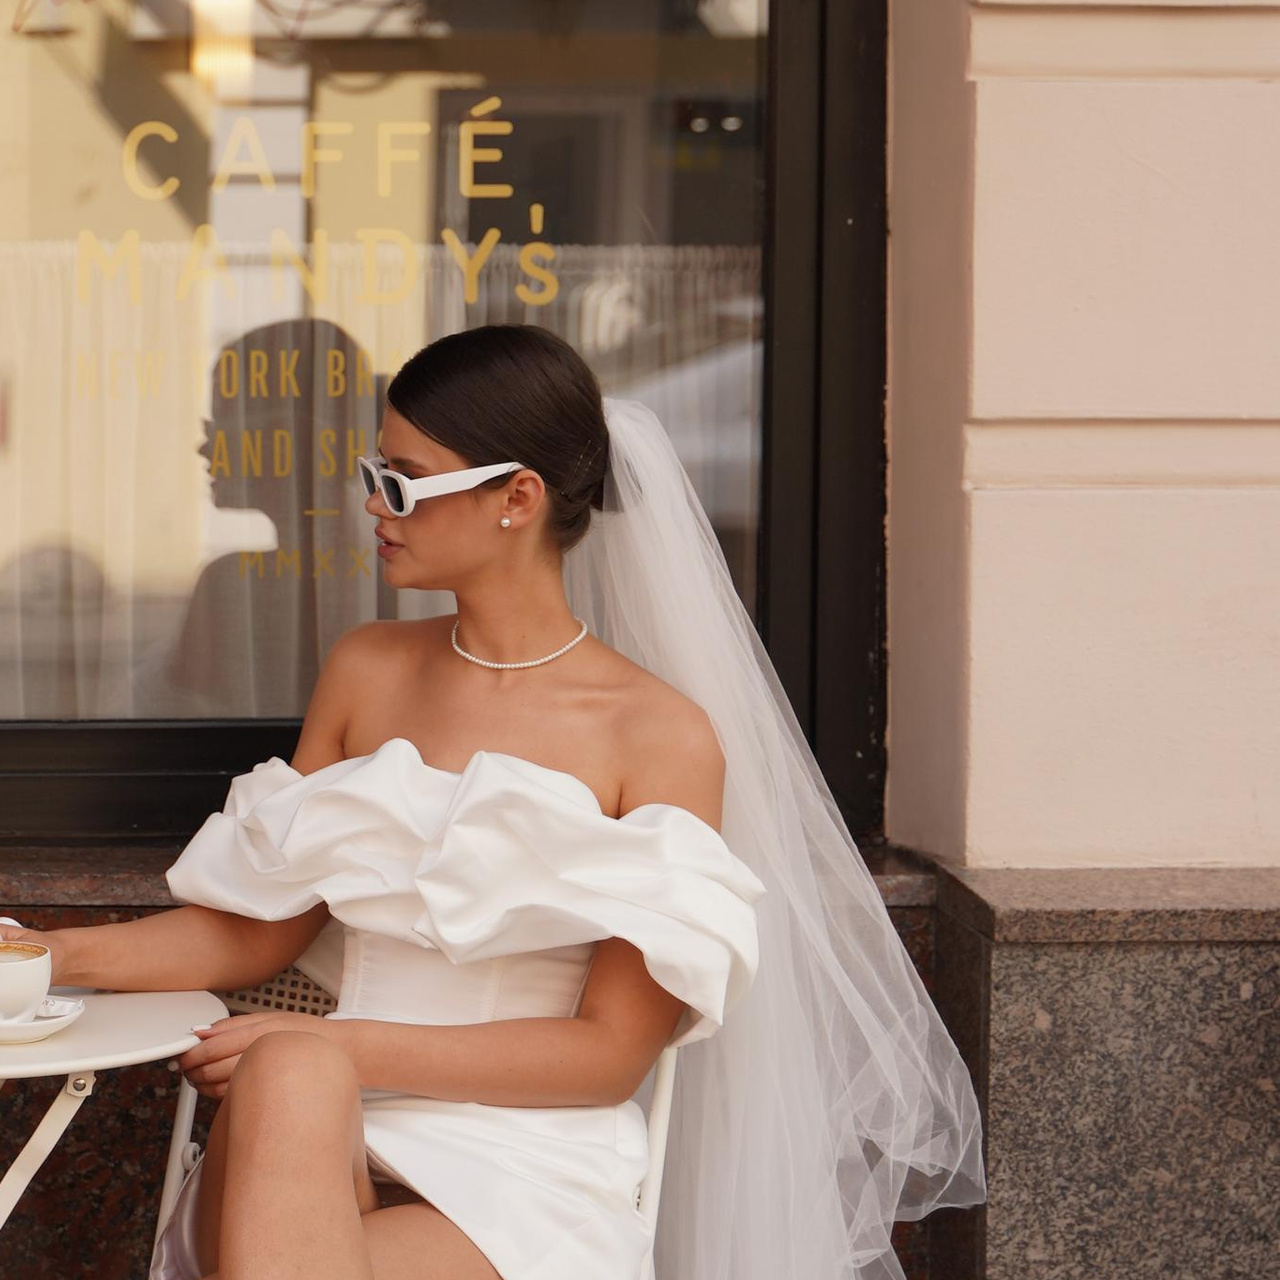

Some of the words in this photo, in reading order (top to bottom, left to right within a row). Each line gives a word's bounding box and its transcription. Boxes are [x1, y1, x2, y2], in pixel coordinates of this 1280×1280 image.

[123, 96, 514, 201] CAFFÉ
[76, 349, 166, 400] NEW
[193, 349, 301, 399] YORK
[211, 429, 294, 478] AND
